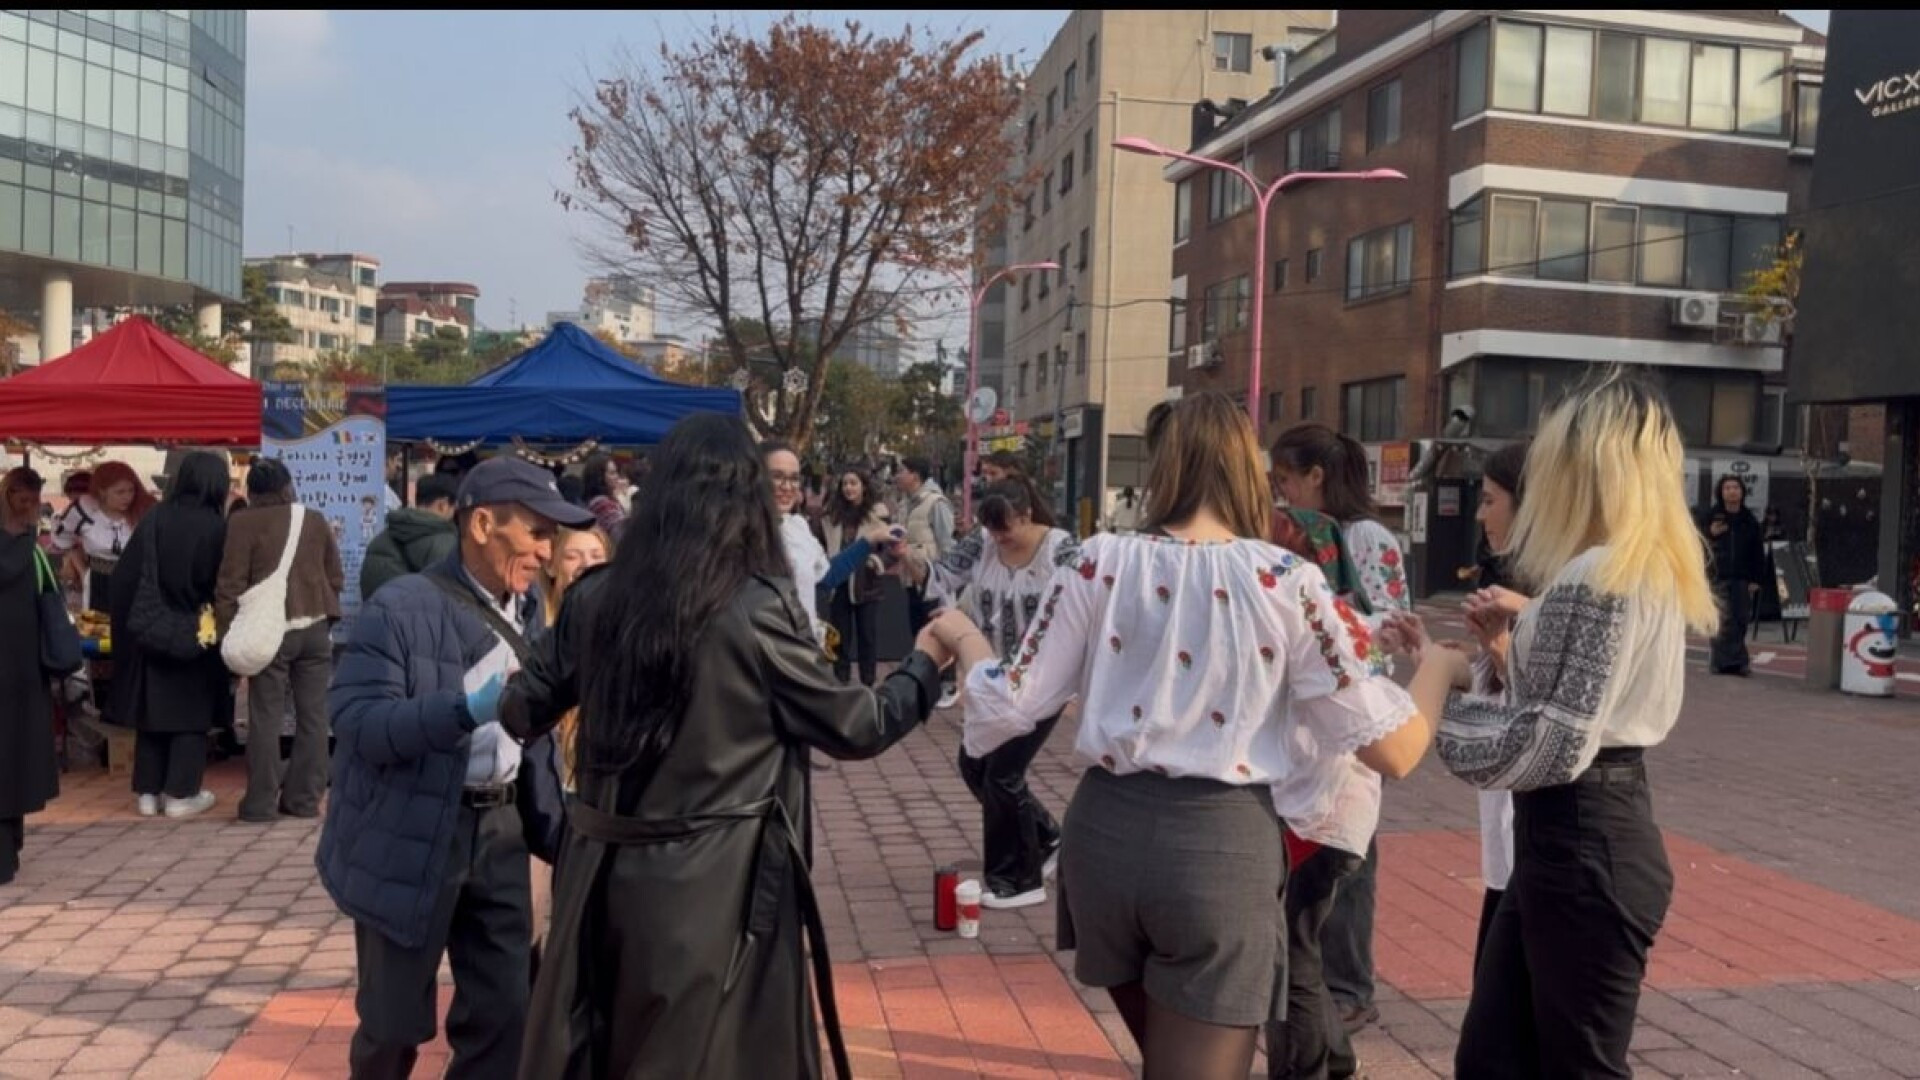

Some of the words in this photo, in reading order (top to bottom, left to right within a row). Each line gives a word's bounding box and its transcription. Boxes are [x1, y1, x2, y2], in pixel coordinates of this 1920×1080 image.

[1871, 95, 1920, 117] GALLER
[295, 469, 331, 487] 국에서
[301, 491, 356, 507] 하합니다
